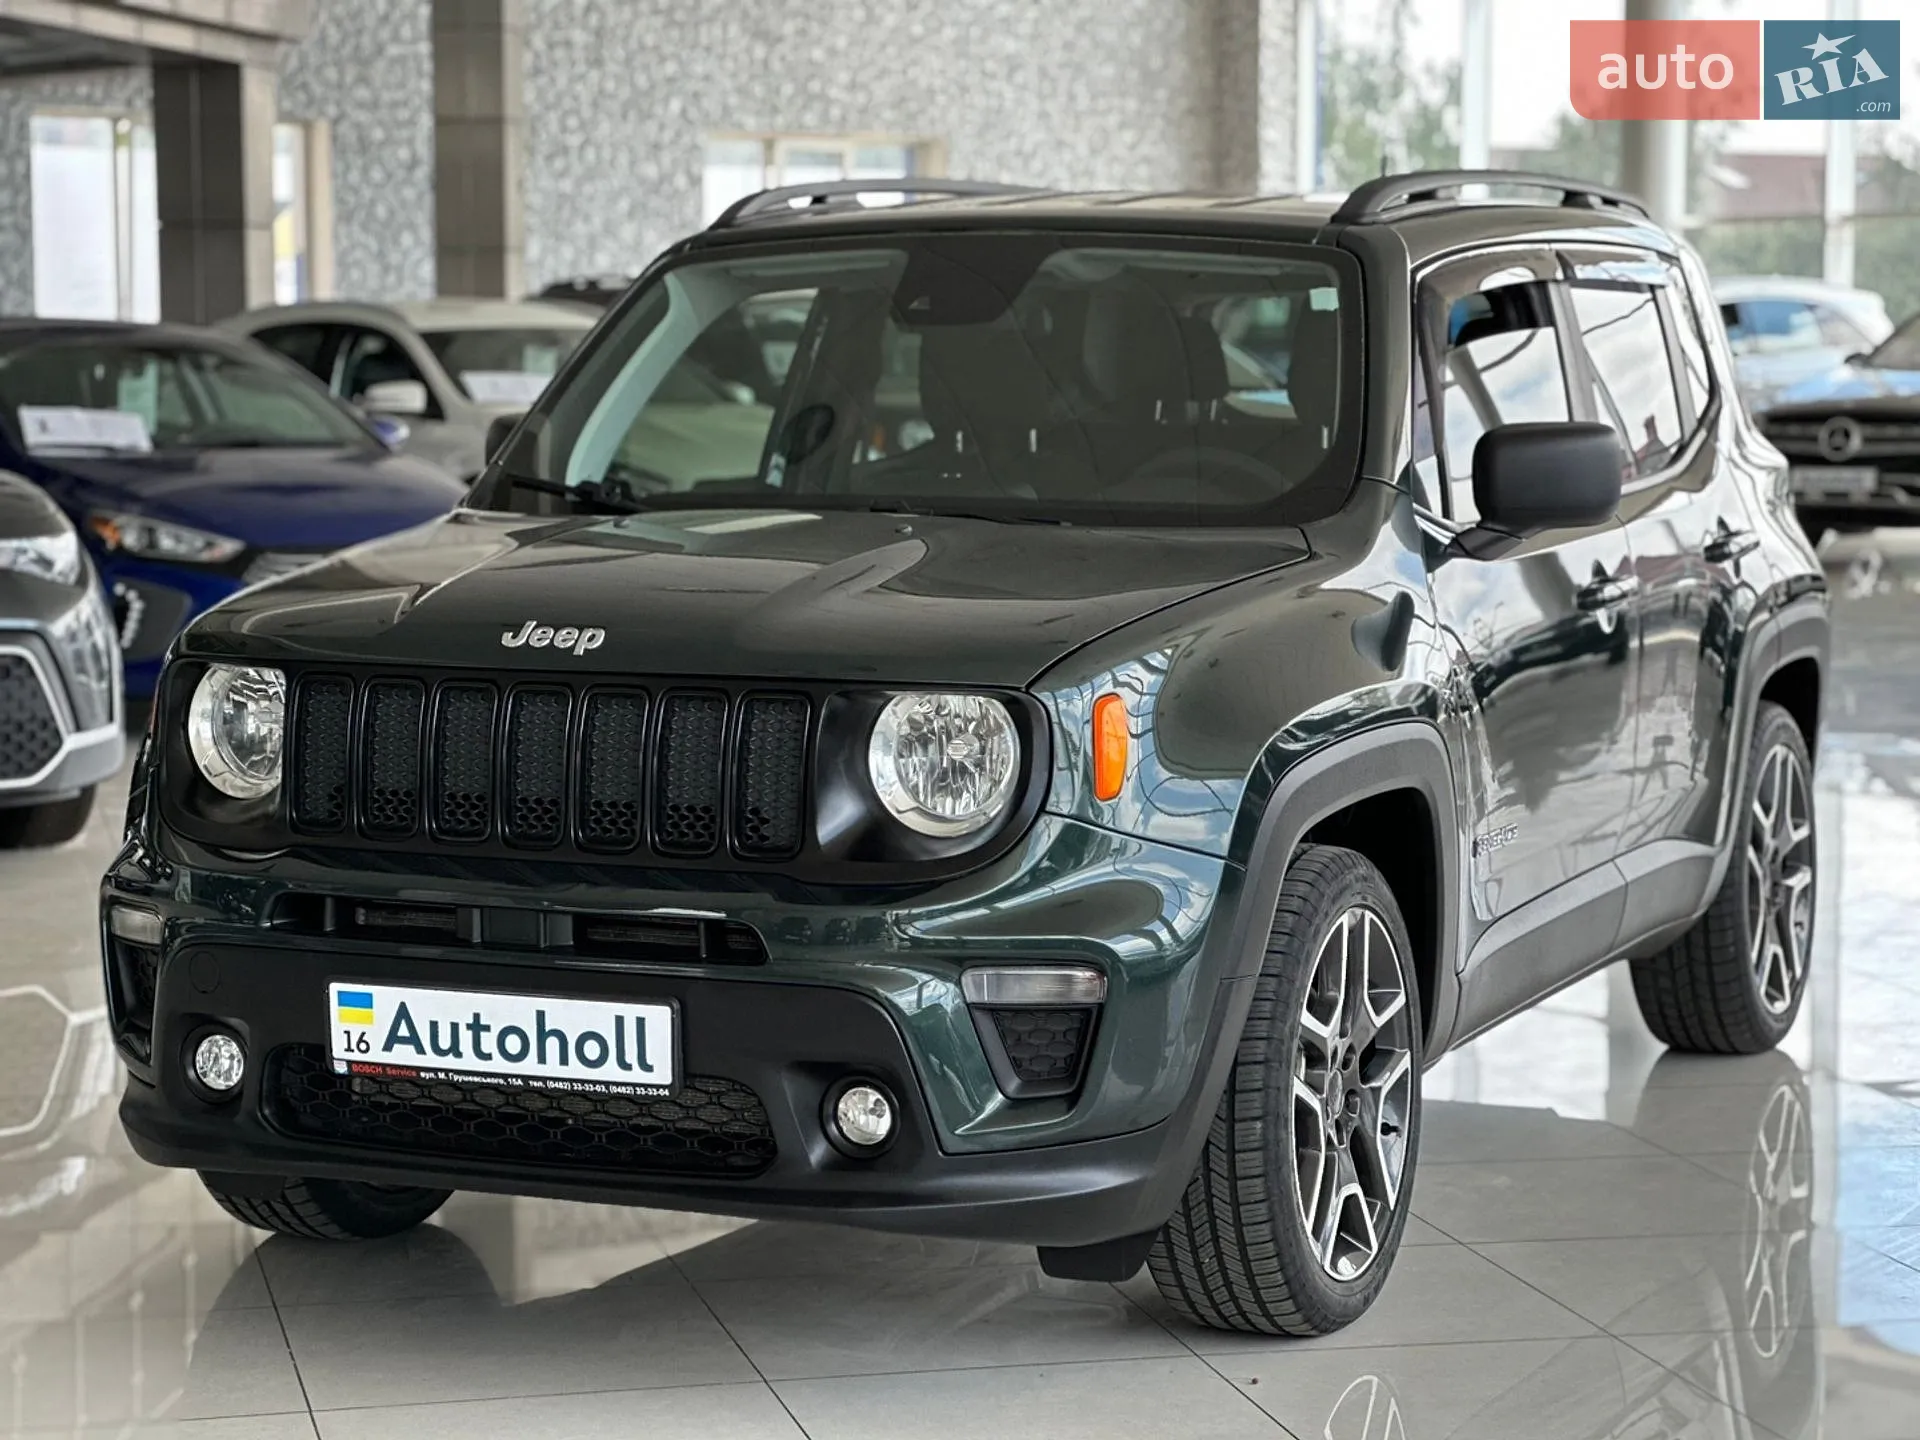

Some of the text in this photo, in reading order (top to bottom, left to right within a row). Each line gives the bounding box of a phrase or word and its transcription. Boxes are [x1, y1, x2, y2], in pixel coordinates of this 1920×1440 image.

[501, 620, 606, 656] Jeep
[343, 1030, 371, 1054] 16
[382, 1001, 654, 1073] Autoholl
[351, 1063, 383, 1075] BOSCH
[386, 1066, 418, 1077] Service
